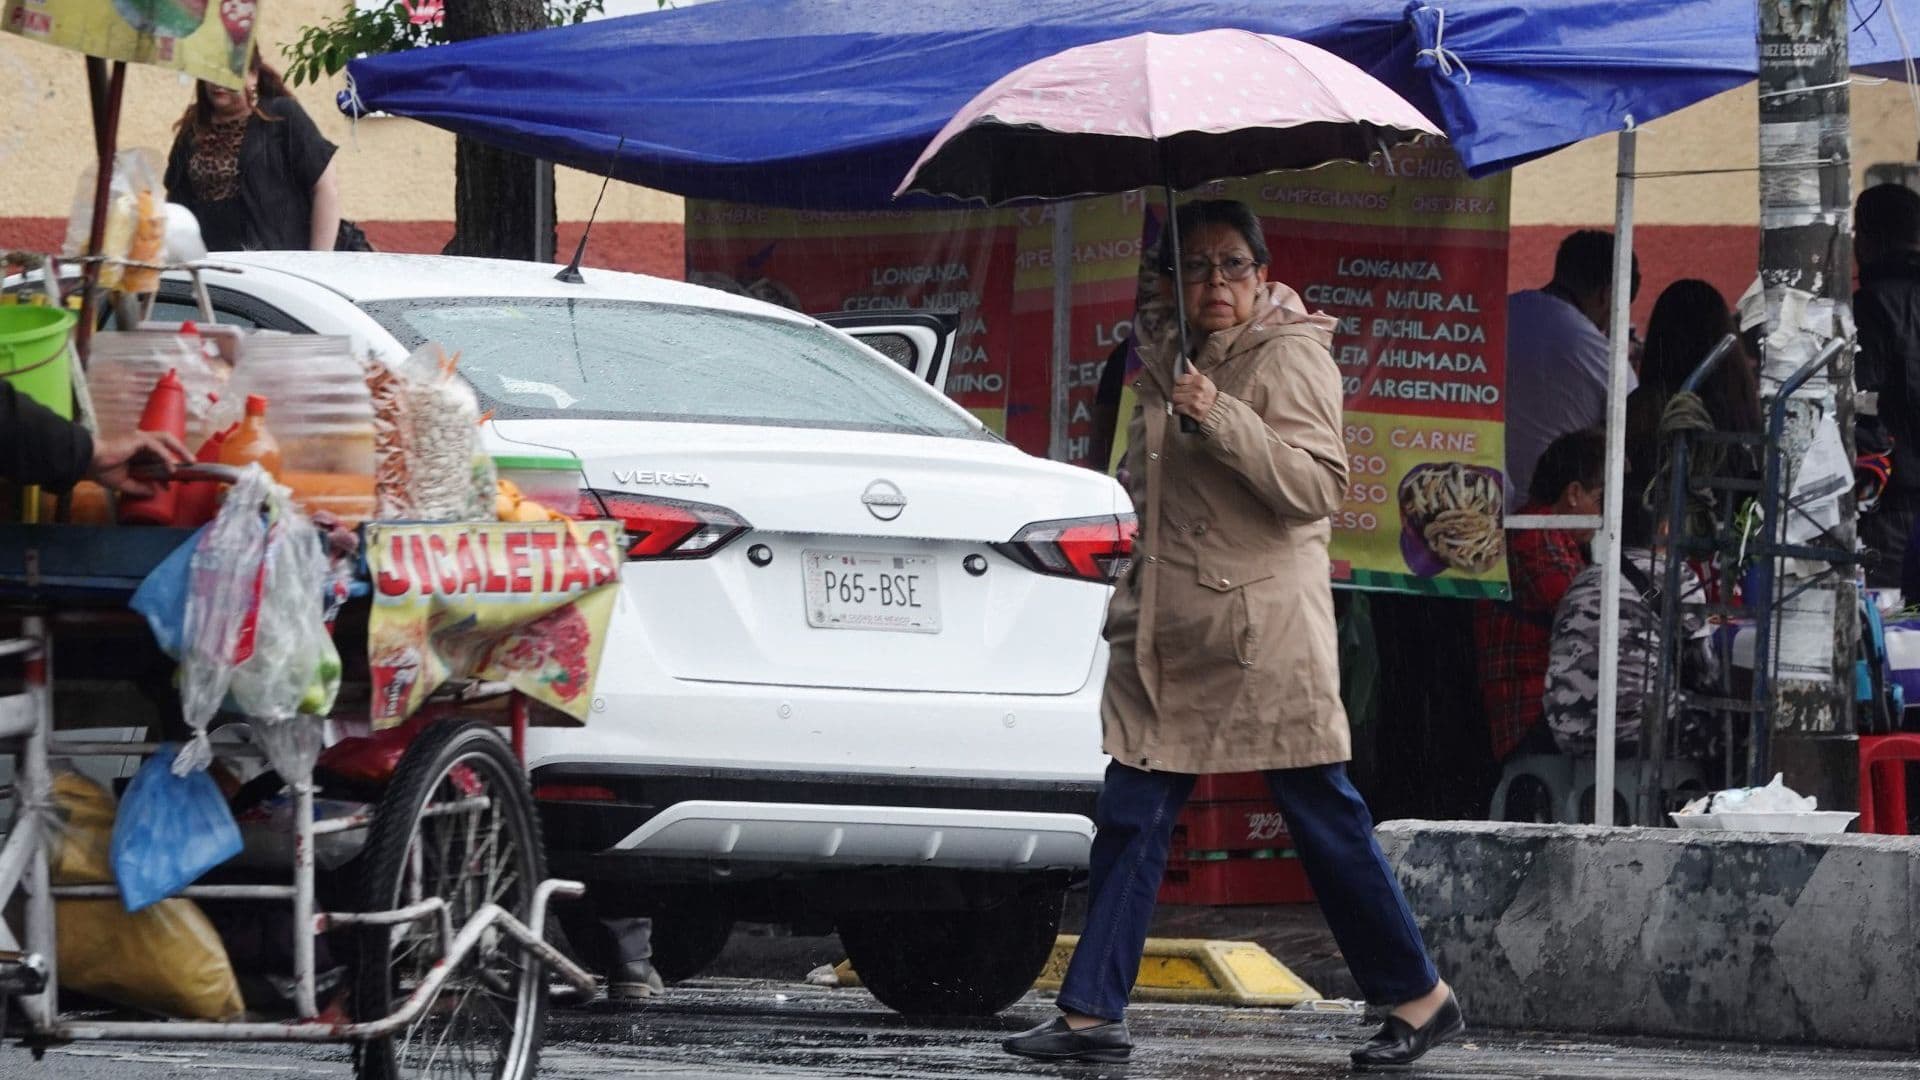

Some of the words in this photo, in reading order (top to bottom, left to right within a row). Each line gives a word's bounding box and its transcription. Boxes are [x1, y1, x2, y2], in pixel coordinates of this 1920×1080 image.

[1261, 186, 1389, 210] CAMPECHANOS
[1303, 285, 1375, 308] CECINA
[1385, 289, 1481, 313] NATURAL
[1371, 318, 1486, 344] ENCHILADA
[1376, 348, 1488, 374] AHUMADA
[1369, 378, 1500, 405] ARGENTINO
[1390, 429, 1477, 453] CARNE
[612, 469, 710, 488] VERSA
[377, 530, 618, 597] JICALETAS
[824, 569, 922, 608] P65-BSE
